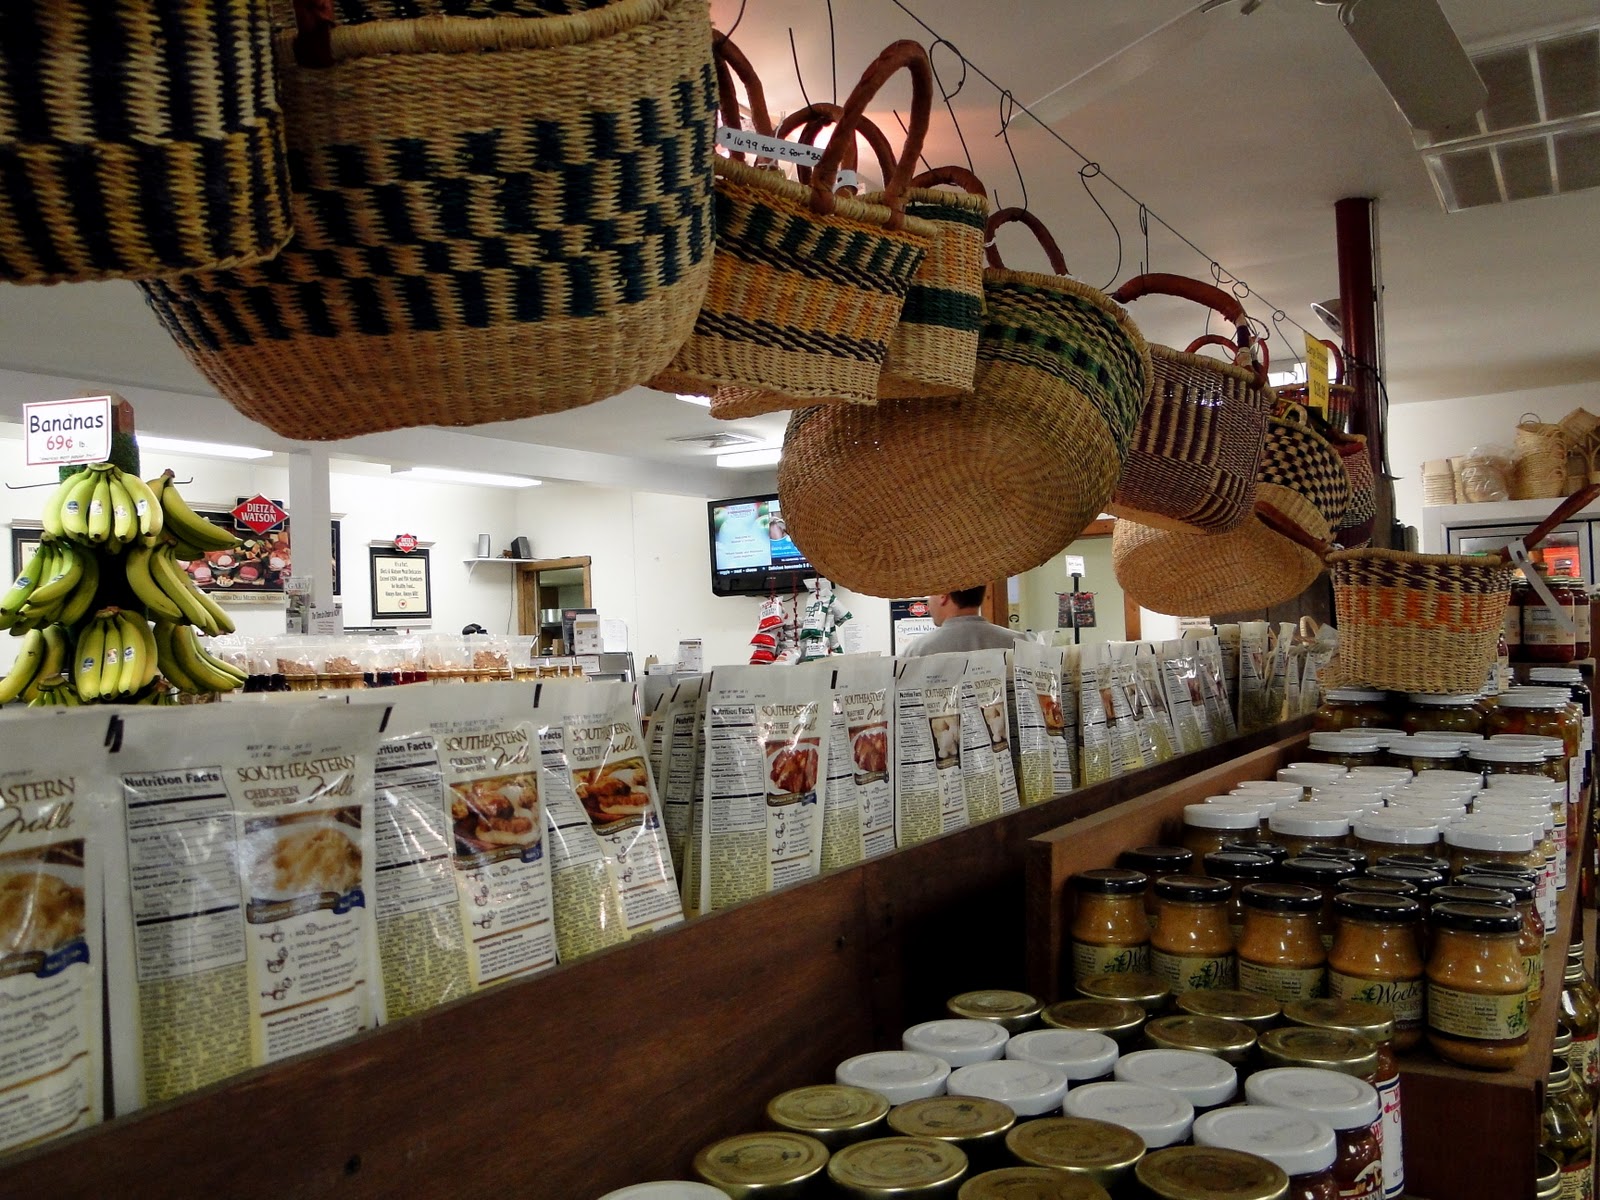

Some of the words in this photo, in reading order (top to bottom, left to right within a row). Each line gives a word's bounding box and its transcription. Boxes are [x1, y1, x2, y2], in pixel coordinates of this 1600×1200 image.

[761, 143, 776, 153] tax
[779, 147, 786, 155] 2
[789, 149, 804, 157] for
[30, 415, 104, 433] Bananas
[46, 435, 73, 451] 69¢
[247, 503, 269, 513] DIETZ
[269, 505, 277, 514] &
[241, 513, 277, 523] WATSON
[897, 624, 921, 634] Special
[407, 741, 433, 751] Facts
[444, 729, 528, 751] SOUTHEASTERN
[237, 755, 356, 782] SOUTHEASTERN
[124, 776, 183, 787] Nutrition
[185, 773, 220, 784] Facts
[244, 785, 299, 800] CHICKEN
